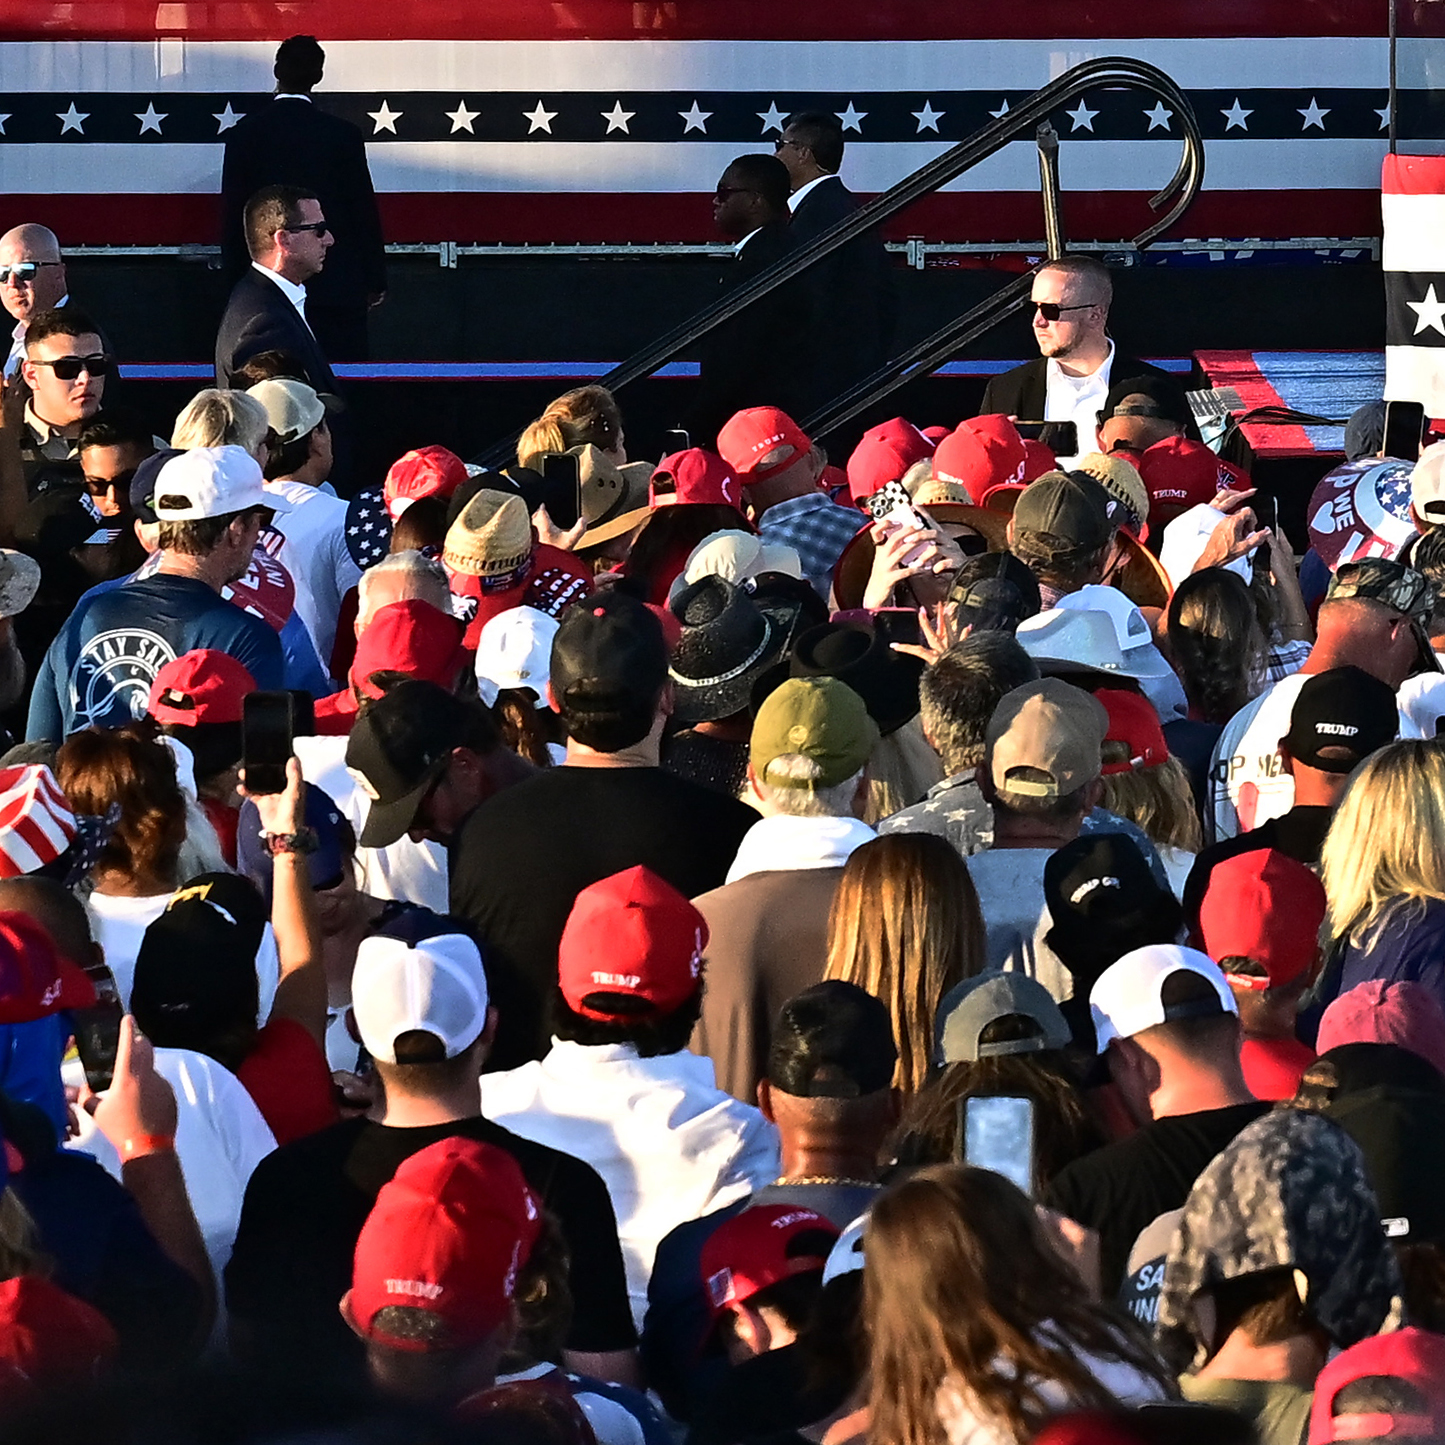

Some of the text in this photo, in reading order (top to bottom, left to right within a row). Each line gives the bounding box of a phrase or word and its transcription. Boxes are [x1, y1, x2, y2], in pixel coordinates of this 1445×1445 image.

[752, 433, 786, 452] TRUMP
[1153, 489, 1187, 499] TRUMP
[81, 636, 127, 675] STAY
[1316, 723, 1358, 736] TRUMP
[591, 972, 640, 987] TRUMP
